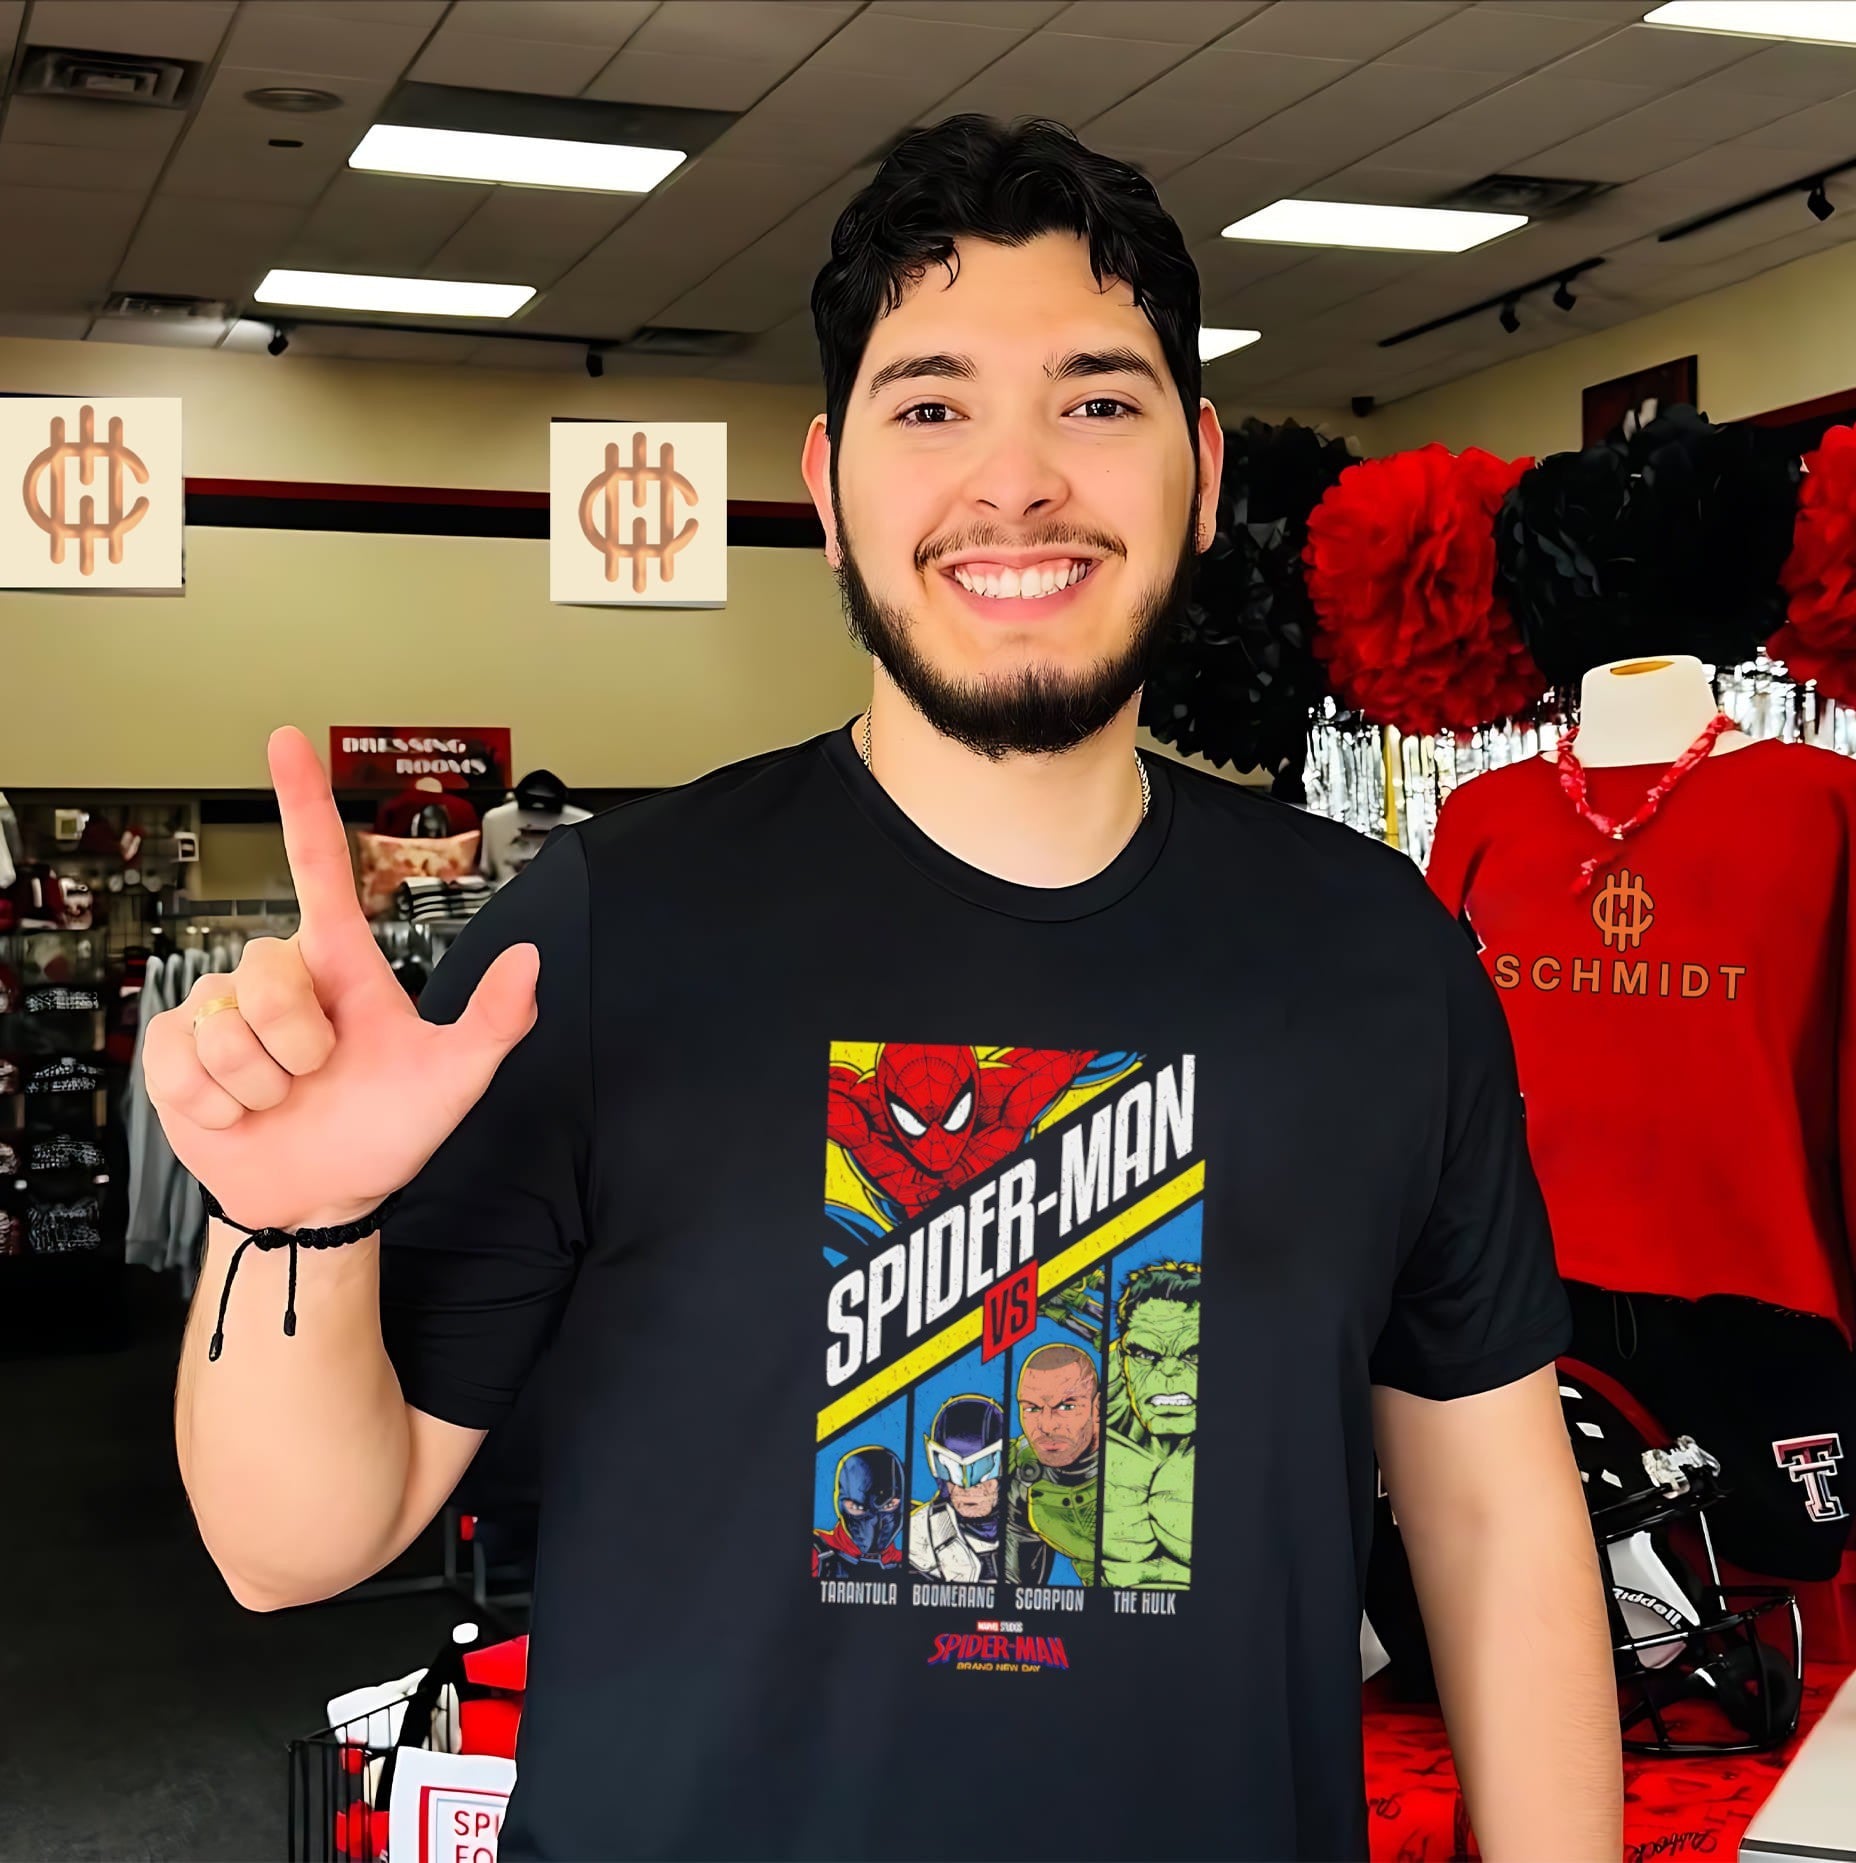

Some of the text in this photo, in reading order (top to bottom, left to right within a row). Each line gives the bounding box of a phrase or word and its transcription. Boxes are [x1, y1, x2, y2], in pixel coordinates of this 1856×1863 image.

[341, 736, 467, 754] DRESSING
[395, 757, 487, 776] ROOMS
[1493, 953, 1747, 1000] SCHMIDT
[826, 1053, 1196, 1388] SPIDER-MAN
[990, 1275, 1029, 1347] VS
[820, 1580, 898, 1606] TARANTULA
[912, 1583, 995, 1609] BOOMERANG
[1015, 1586, 1085, 1612] SCORPION
[1113, 1590, 1177, 1615] THE HULK
[927, 1633, 1070, 1669] SPIDER-MAN
[956, 1661, 1041, 1673] BRAND NEW DAY
